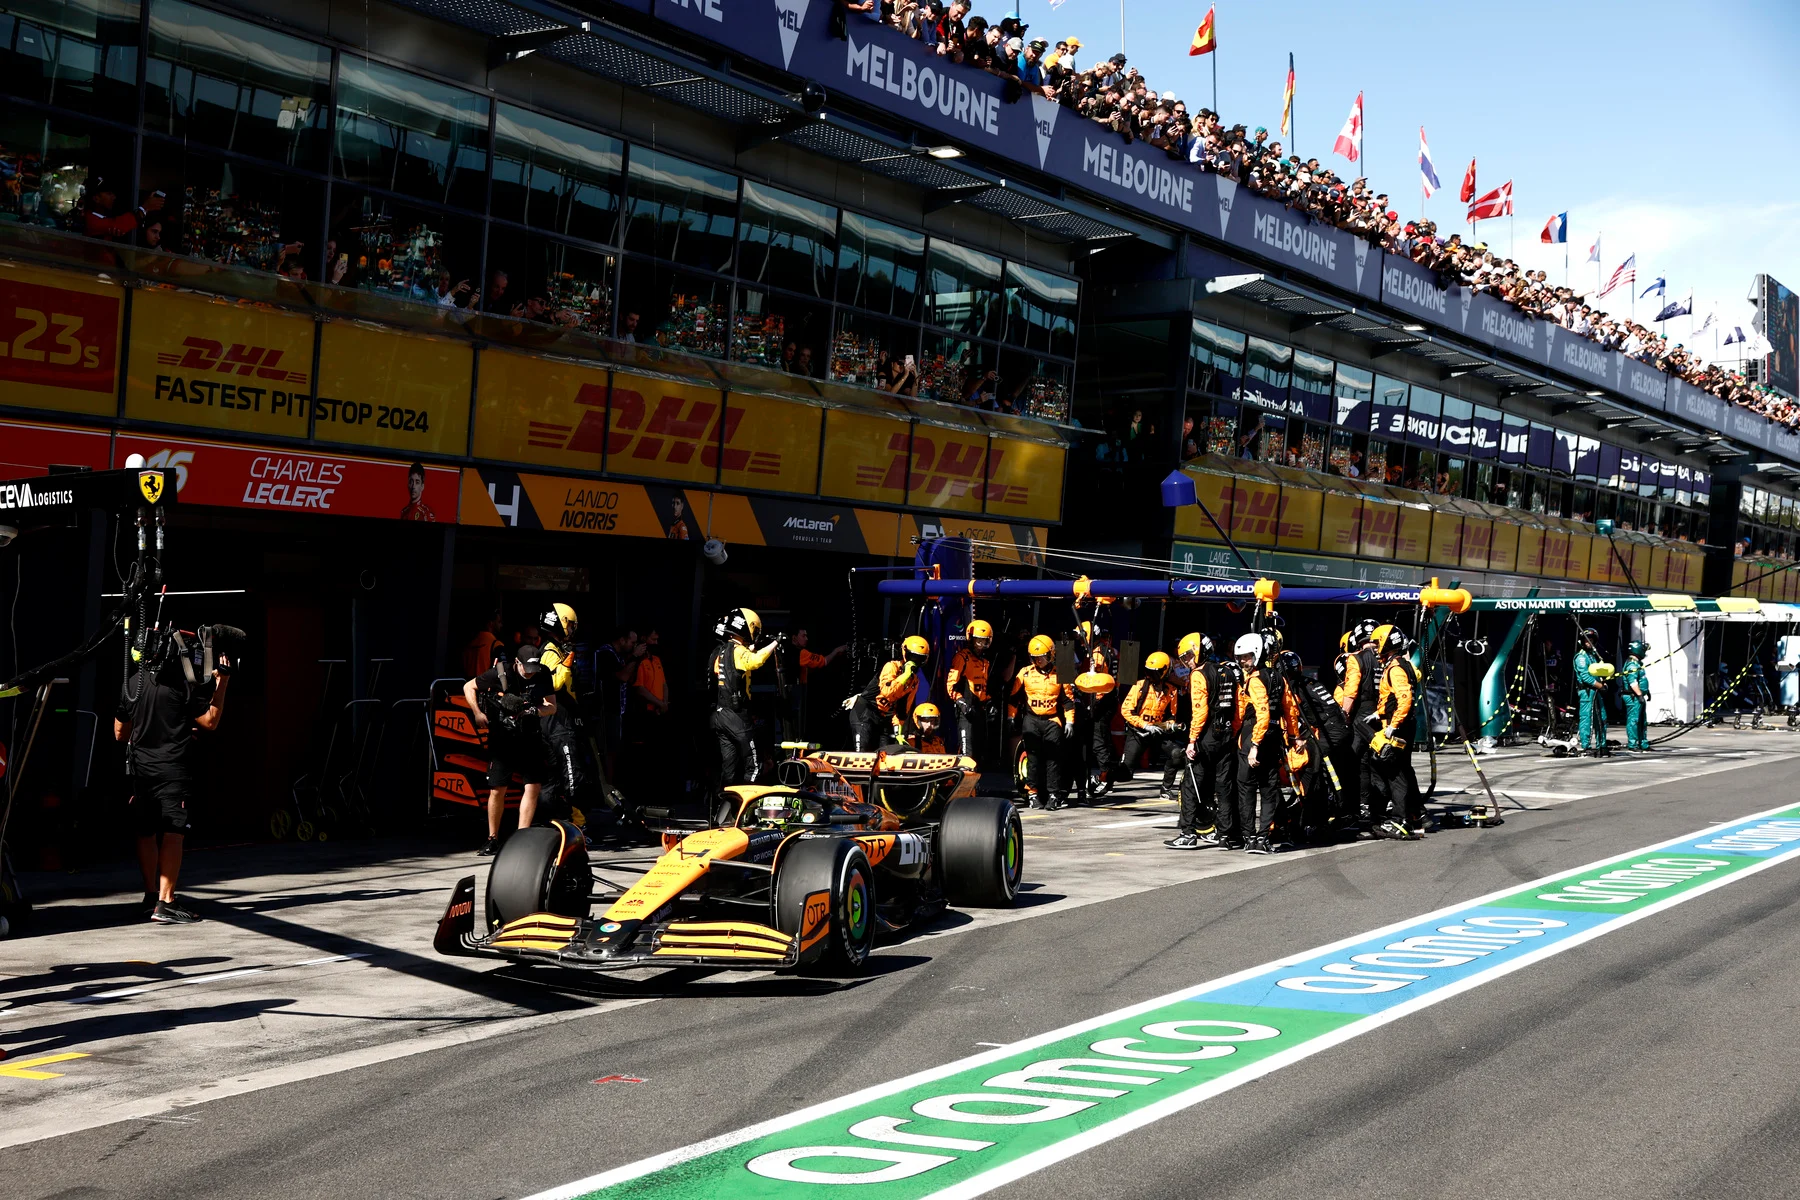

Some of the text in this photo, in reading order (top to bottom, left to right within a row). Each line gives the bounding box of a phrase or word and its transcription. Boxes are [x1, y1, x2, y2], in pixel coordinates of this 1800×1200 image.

[776, 5, 801, 33] MEL
[846, 33, 1000, 137] MELBOURNE
[1034, 118, 1051, 138] MEL
[1083, 136, 1194, 213] MELBOURNE
[1253, 208, 1337, 271] MELBOURNE
[1382, 263, 1447, 315] MELBOURNE
[1481, 307, 1536, 349] MELBOURNE
[178, 336, 290, 382] DHL
[1563, 340, 1608, 378] MELBOURNE
[154, 374, 267, 412] FASTEST
[376, 405, 429, 433] 2024
[566, 383, 750, 472] DHL
[249, 456, 346, 485] CHARLES
[882, 432, 1009, 504] DHL
[34, 489, 73, 507] LOGISTICS
[242, 481, 336, 510] LECLERC
[488, 482, 521, 527] 4
[563, 488, 620, 510] LANDO
[1216, 486, 1290, 537] DHL
[559, 510, 619, 531] NORRIS
[782, 516, 834, 532] McLaren
[964, 527, 996, 543] OSCAR
[1183, 552, 1194, 574] 18
[1208, 551, 1231, 565] LANCE
[1199, 584, 1255, 594] DP WORLD
[1370, 591, 1421, 600] DP WORLD
[1494, 600, 1617, 610] ASTON MARTIN aramco
[1535, 857, 1732, 905] aramco
[1275, 914, 1570, 995] aramco
[744, 1019, 1282, 1186] aramco
